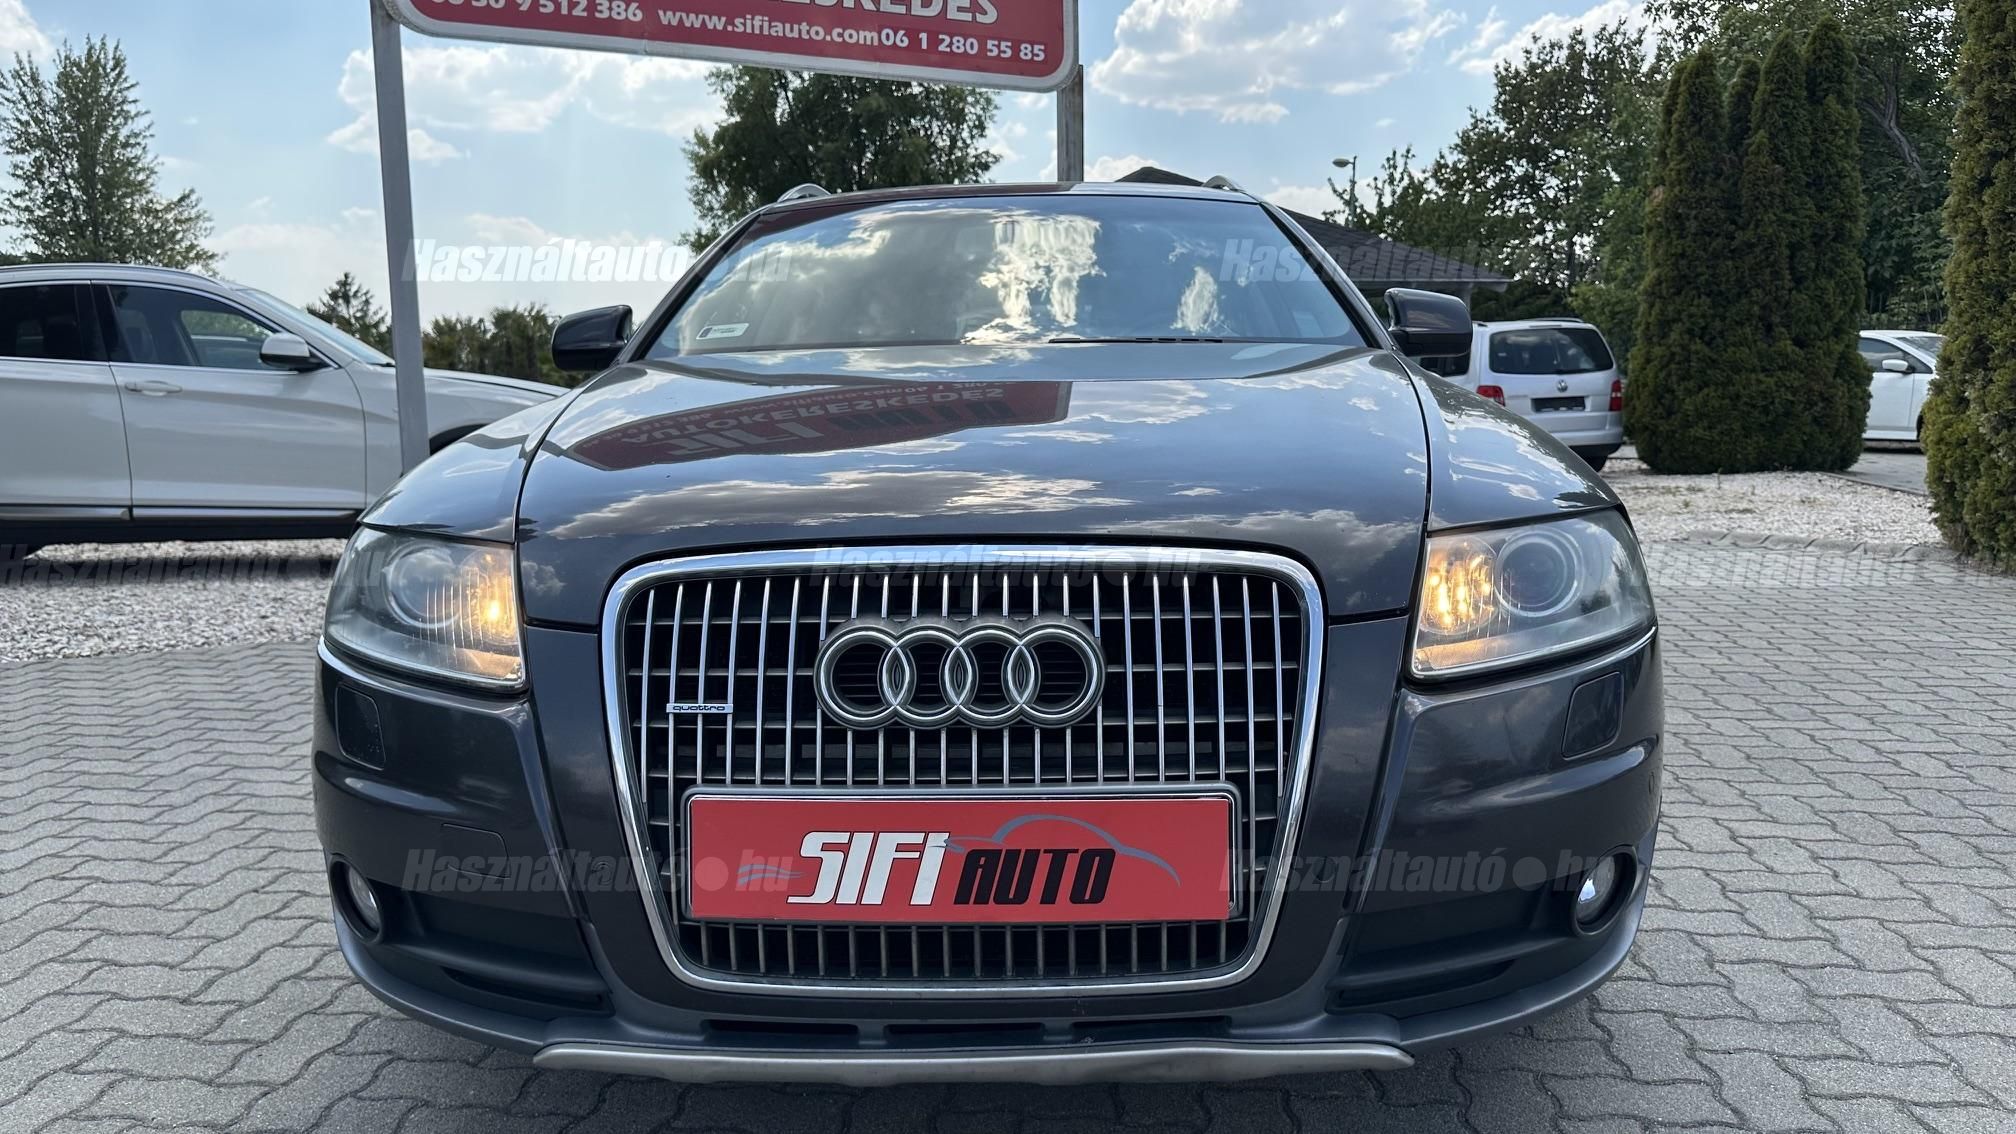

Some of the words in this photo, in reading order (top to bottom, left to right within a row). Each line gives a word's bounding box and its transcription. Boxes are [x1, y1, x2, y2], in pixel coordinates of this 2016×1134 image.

[539, 0, 588, 17] 512
[595, 0, 643, 22] 386
[657, 9, 878, 46] www.sifiauto.com
[881, 28, 909, 47] 06
[918, 32, 928, 50] 1
[938, 34, 979, 54] 280
[986, 39, 1012, 58] 55
[1019, 43, 1046, 61] 85
[673, 704, 726, 712] quattro
[953, 848, 1117, 905] AUTO
